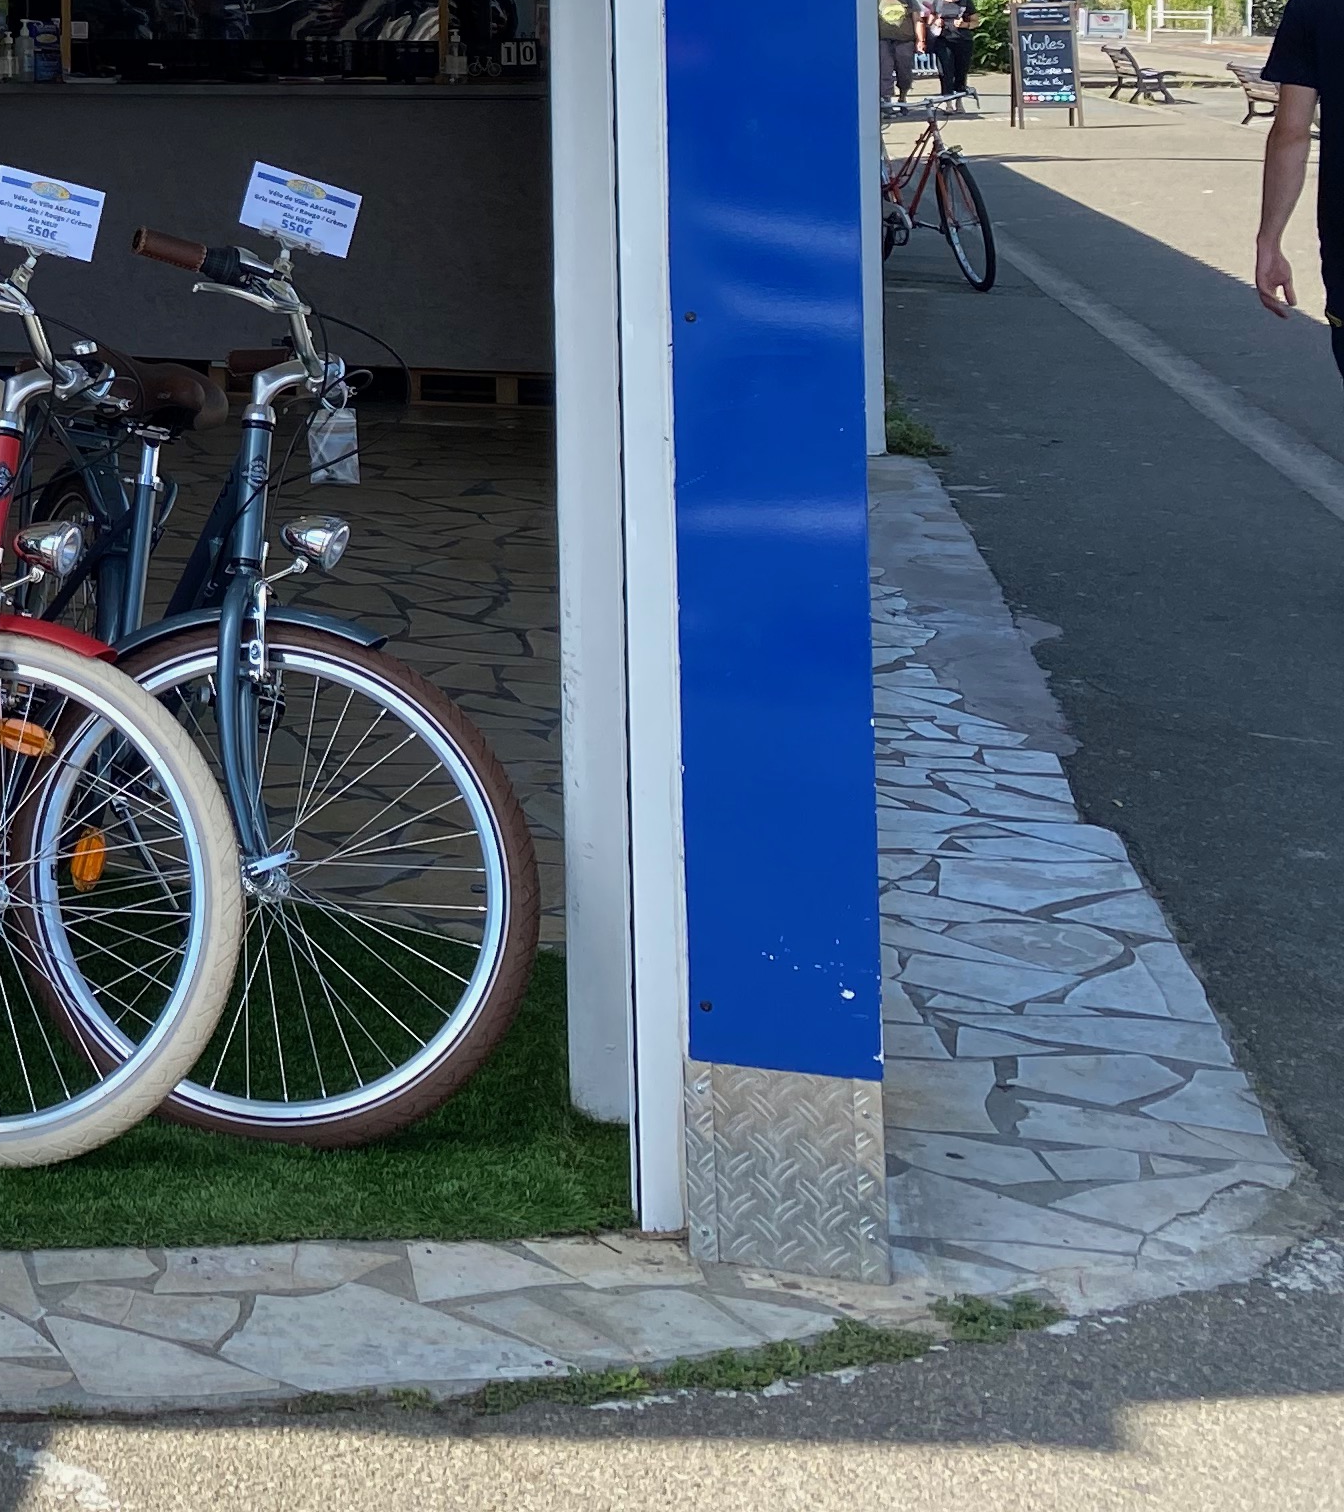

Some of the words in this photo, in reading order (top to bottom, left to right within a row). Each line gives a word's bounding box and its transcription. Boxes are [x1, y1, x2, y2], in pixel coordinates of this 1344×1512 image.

[1021, 34, 1066, 52] Moules
[27, 224, 58, 241] 550€
[280, 219, 313, 237] 550€
